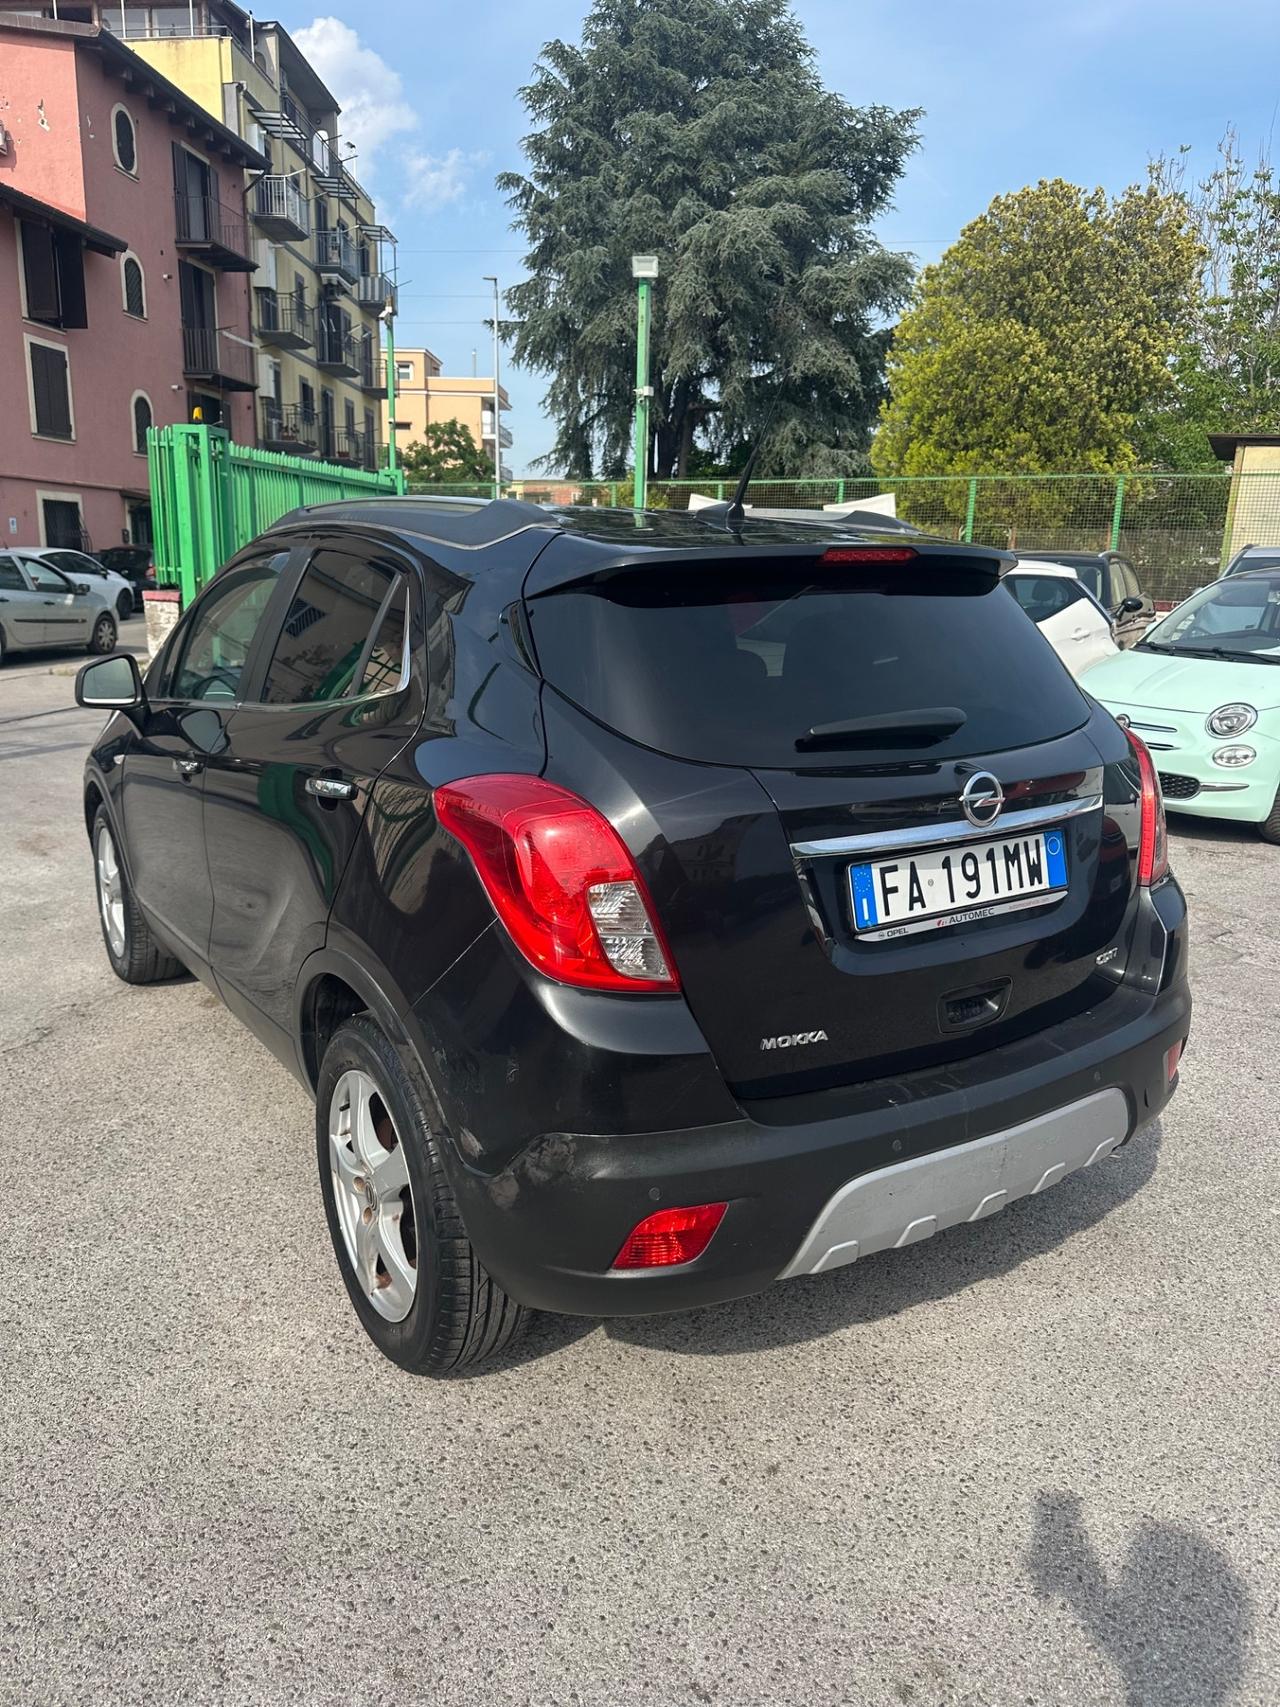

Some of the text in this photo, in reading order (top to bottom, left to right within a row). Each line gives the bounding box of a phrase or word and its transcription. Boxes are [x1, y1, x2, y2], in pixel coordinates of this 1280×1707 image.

[879, 838, 1044, 917] FA 191MW
[886, 907, 995, 938] OPEL AUTOMEC
[760, 1029, 829, 1051] MOKKA
